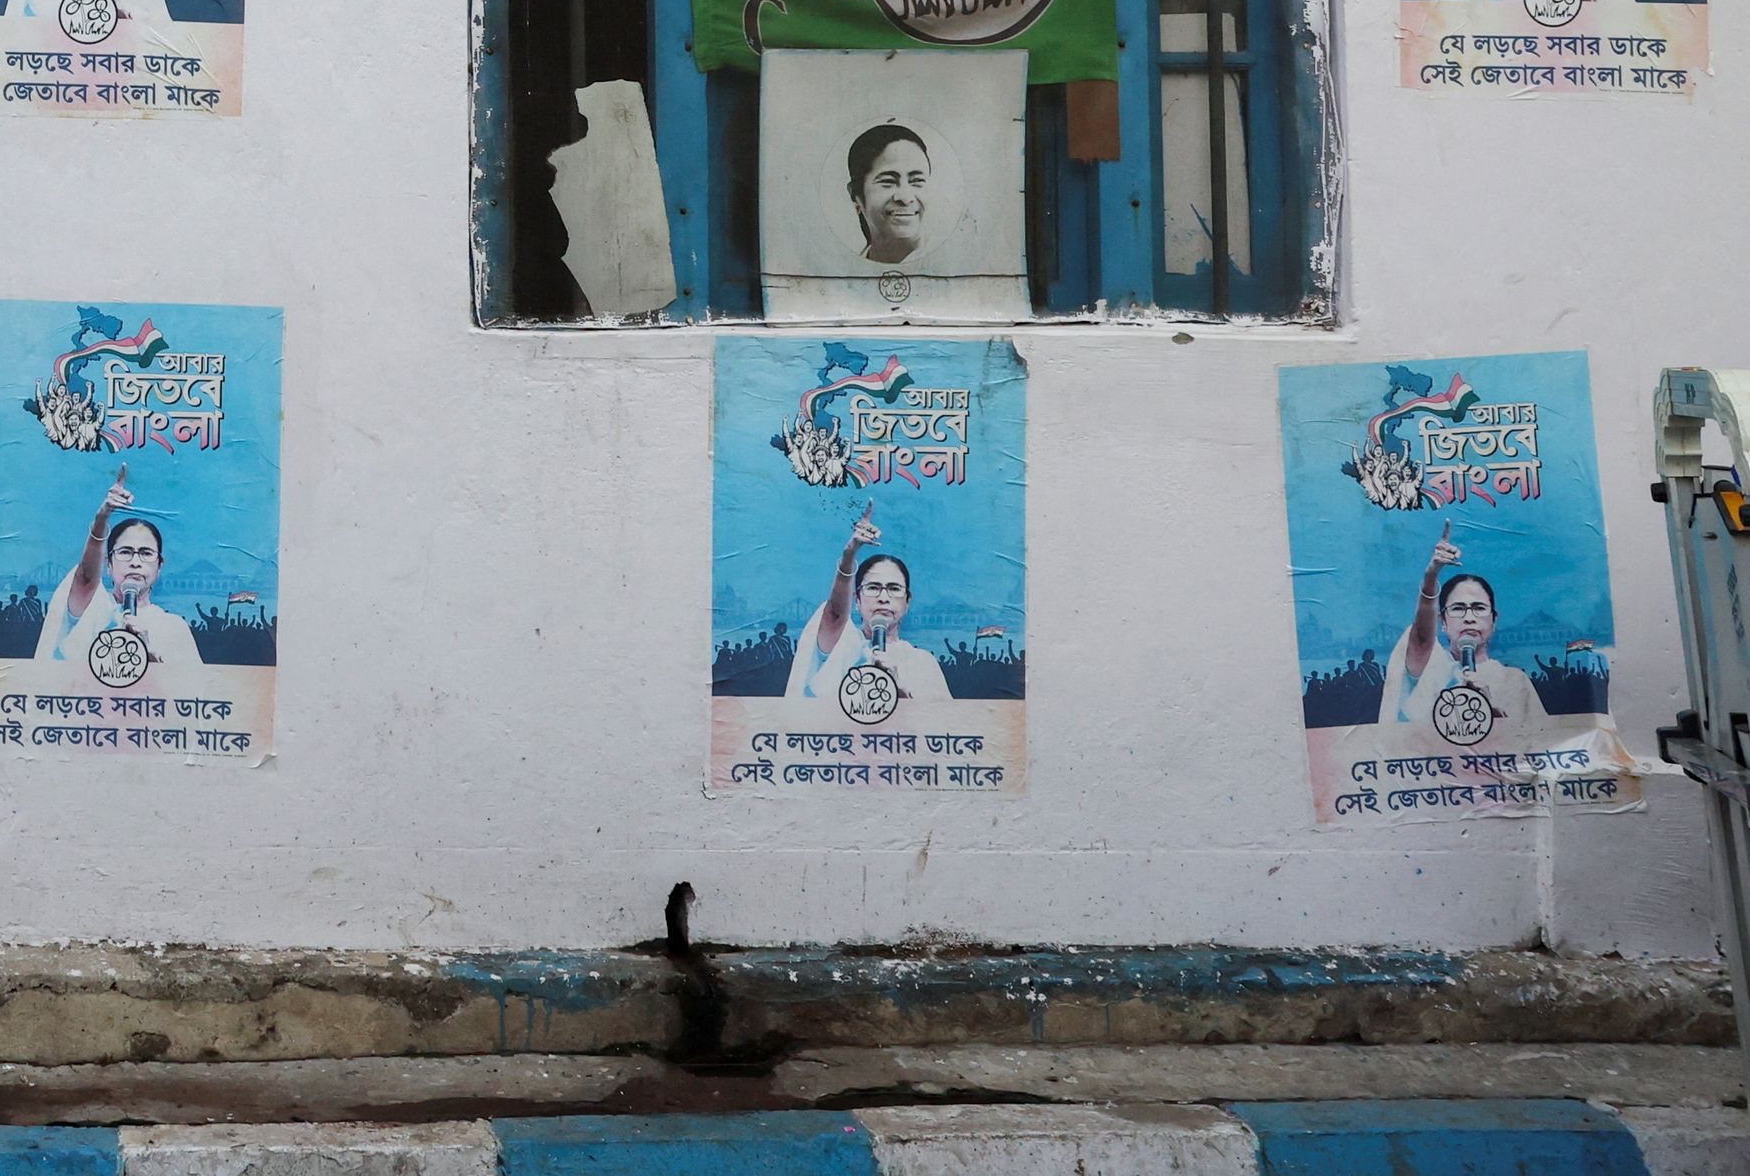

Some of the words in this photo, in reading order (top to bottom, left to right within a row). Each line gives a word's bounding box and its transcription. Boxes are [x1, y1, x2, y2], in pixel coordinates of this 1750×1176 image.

[1439, 34, 1466, 55] যে
[1473, 34, 1539, 58] লড়ছে
[1546, 35, 1600, 56] সবার
[1610, 36, 1667, 58] ডাকে
[5, 51, 73, 75] লড়ছে
[81, 52, 135, 74] সবার
[143, 54, 202, 76] ডাকে
[1420, 59, 1464, 86] সেই
[1471, 65, 1555, 86] জেতাবে
[1563, 65, 1622, 87] বাংলা
[1631, 66, 1687, 89] মাকে
[3, 81, 88, 104] জেতাবে
[96, 82, 156, 106] বাংলা
[164, 85, 221, 108] মাকে
[155, 353, 225, 374] আবার
[104, 359, 225, 408] জিতবে
[899, 387, 970, 409] আবার
[850, 394, 970, 444] জিতবে
[1467, 402, 1537, 425] আবার
[107, 409, 224, 455] বাংলা
[1419, 415, 1539, 465] জিতবে
[853, 444, 969, 490] বাংলা
[1426, 459, 1541, 507] বাংলা
[0, 694, 27, 714] যে
[35, 694, 103, 719] লড়ছে
[111, 695, 166, 717] সবার
[174, 697, 233, 720] ডাকে
[32, 724, 118, 747] জেতাবে
[126, 726, 187, 750] বাংলা
[196, 728, 252, 752] মাকে
[751, 732, 779, 752] যে
[786, 732, 854, 757] লড়ছে
[861, 732, 917, 755] সবার
[925, 733, 984, 755] ডাকে
[731, 757, 776, 785] সেই
[783, 762, 870, 785] জেতাবে
[878, 762, 938, 786] বাংলা
[947, 764, 1004, 787] মাকে
[1351, 760, 1378, 782] যে
[1386, 756, 1453, 780] লড়ছে
[1461, 753, 1517, 776] সবার
[1335, 787, 1378, 816] সেই
[1387, 785, 1475, 810] জেতাবে
[1556, 778, 1618, 802] মাকে
